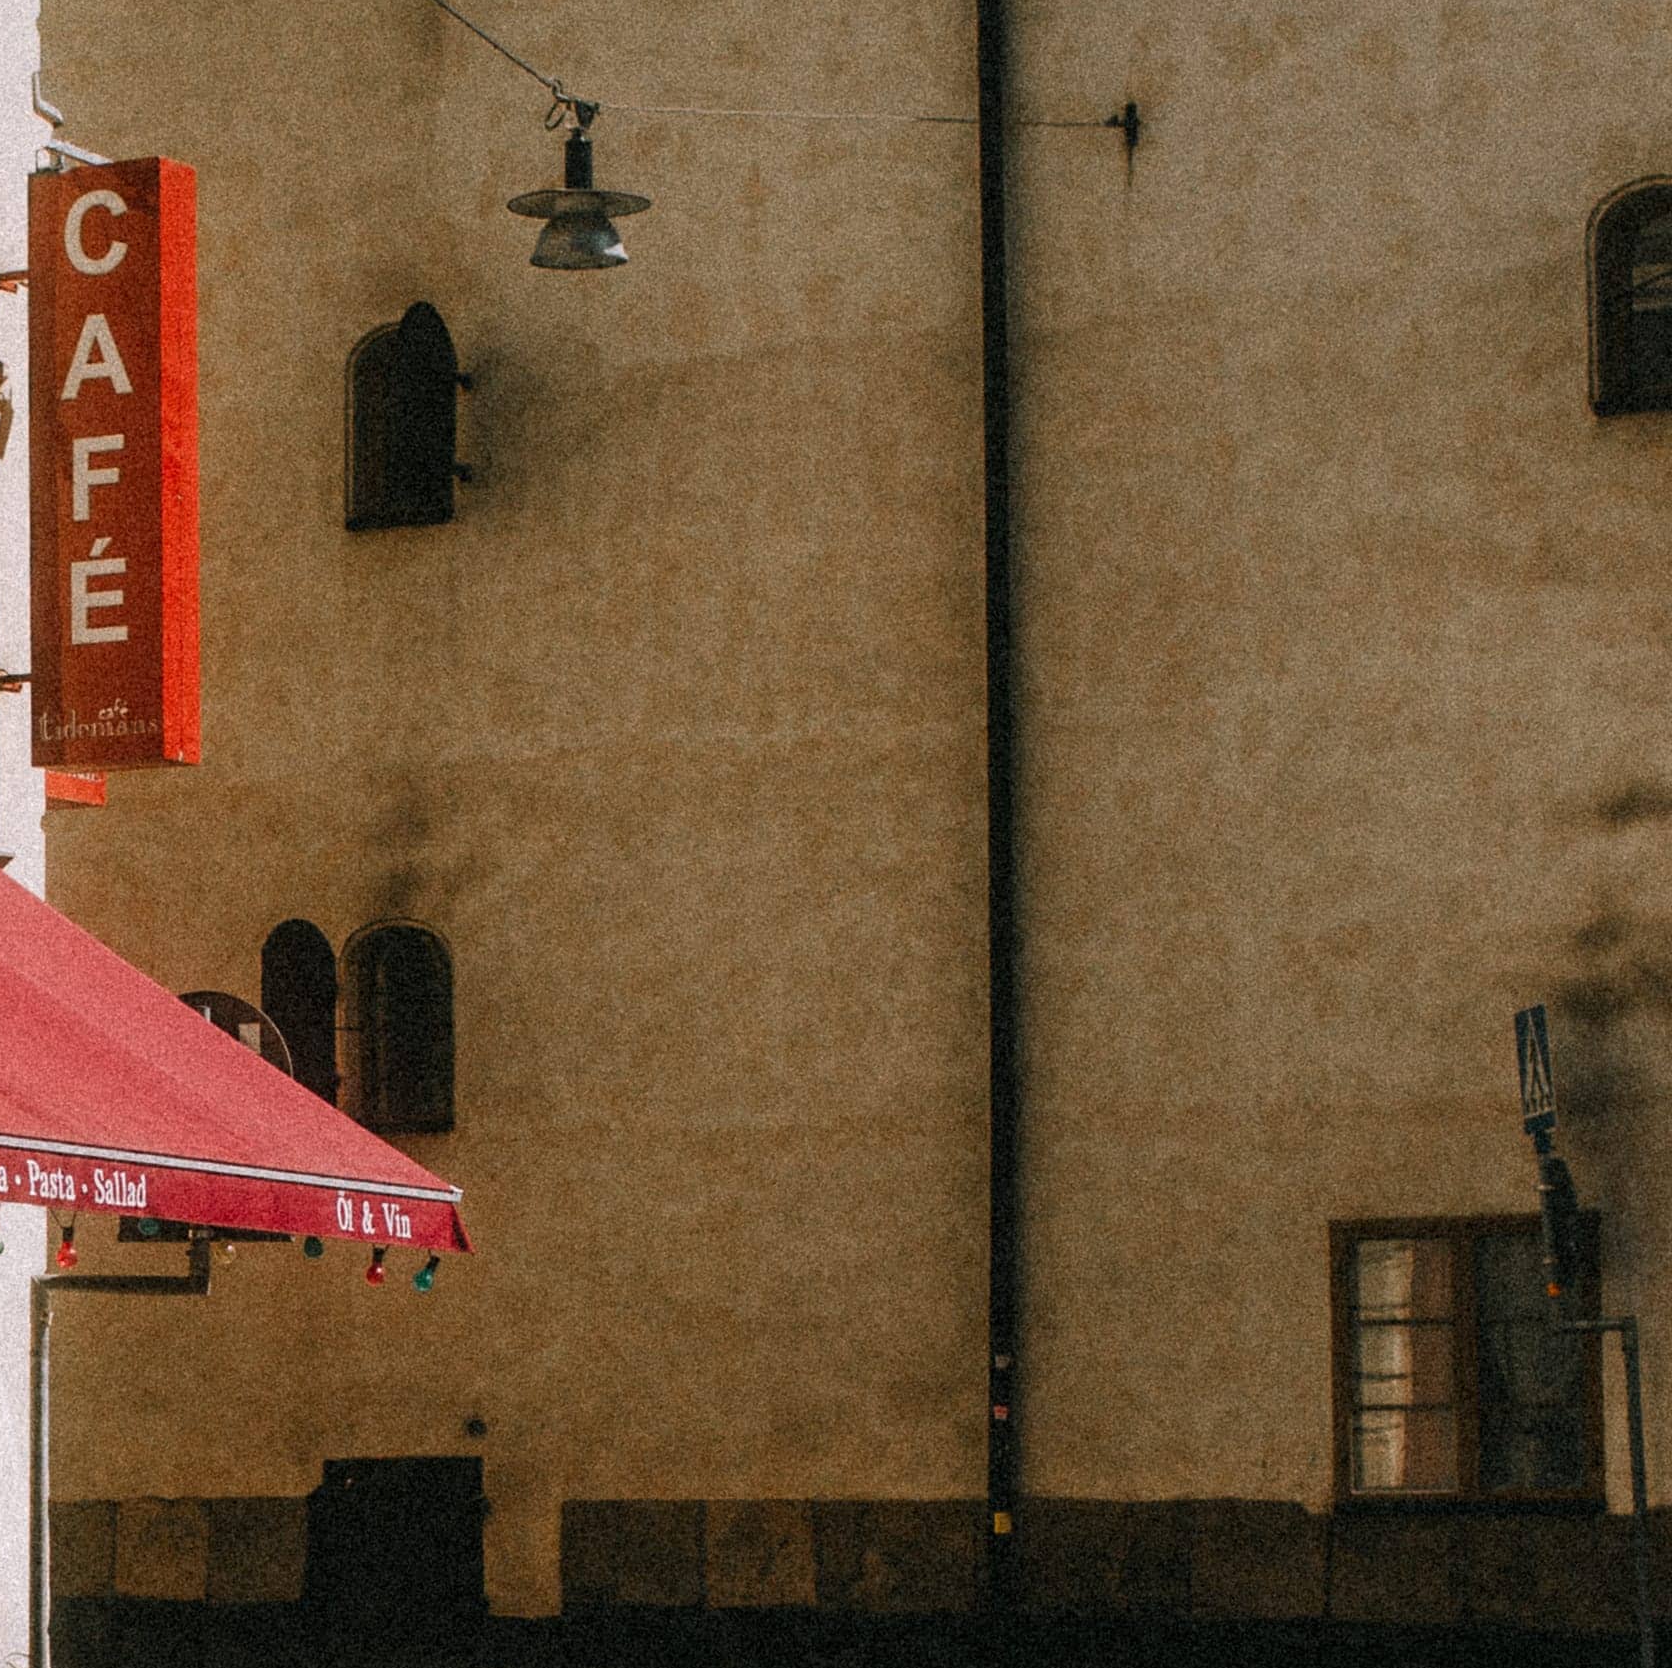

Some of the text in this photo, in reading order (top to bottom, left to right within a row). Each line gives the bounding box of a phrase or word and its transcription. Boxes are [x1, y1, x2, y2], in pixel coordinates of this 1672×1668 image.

[60, 189, 133, 646] CAFÉ
[26, 1159, 76, 1201] Pasta
[93, 1168, 148, 1209] Sallad
[336, 1190, 412, 1239] Öl & Vin
